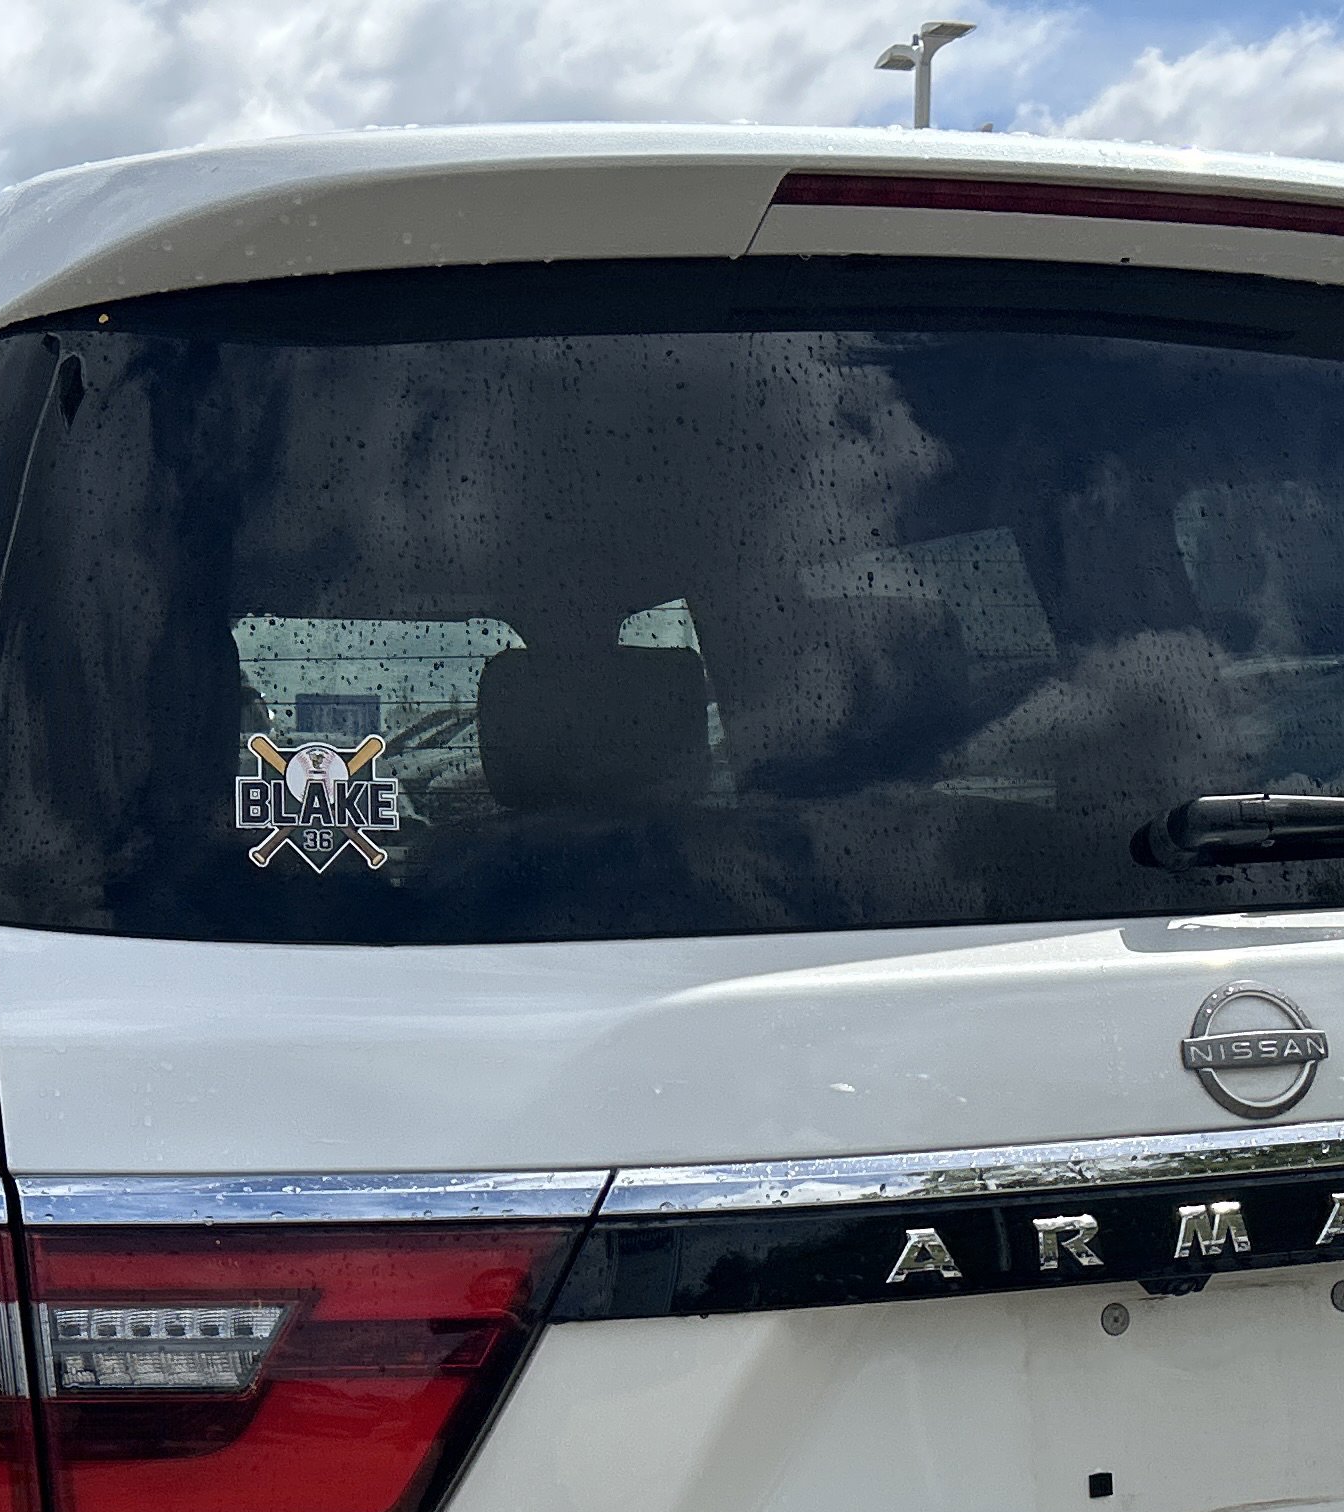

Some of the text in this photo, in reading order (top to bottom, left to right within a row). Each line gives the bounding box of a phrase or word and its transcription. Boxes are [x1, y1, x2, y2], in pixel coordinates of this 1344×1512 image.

[236, 778, 398, 829] BLAKE
[304, 829, 334, 851] 36
[1189, 1037, 1325, 1063] NISSAN
